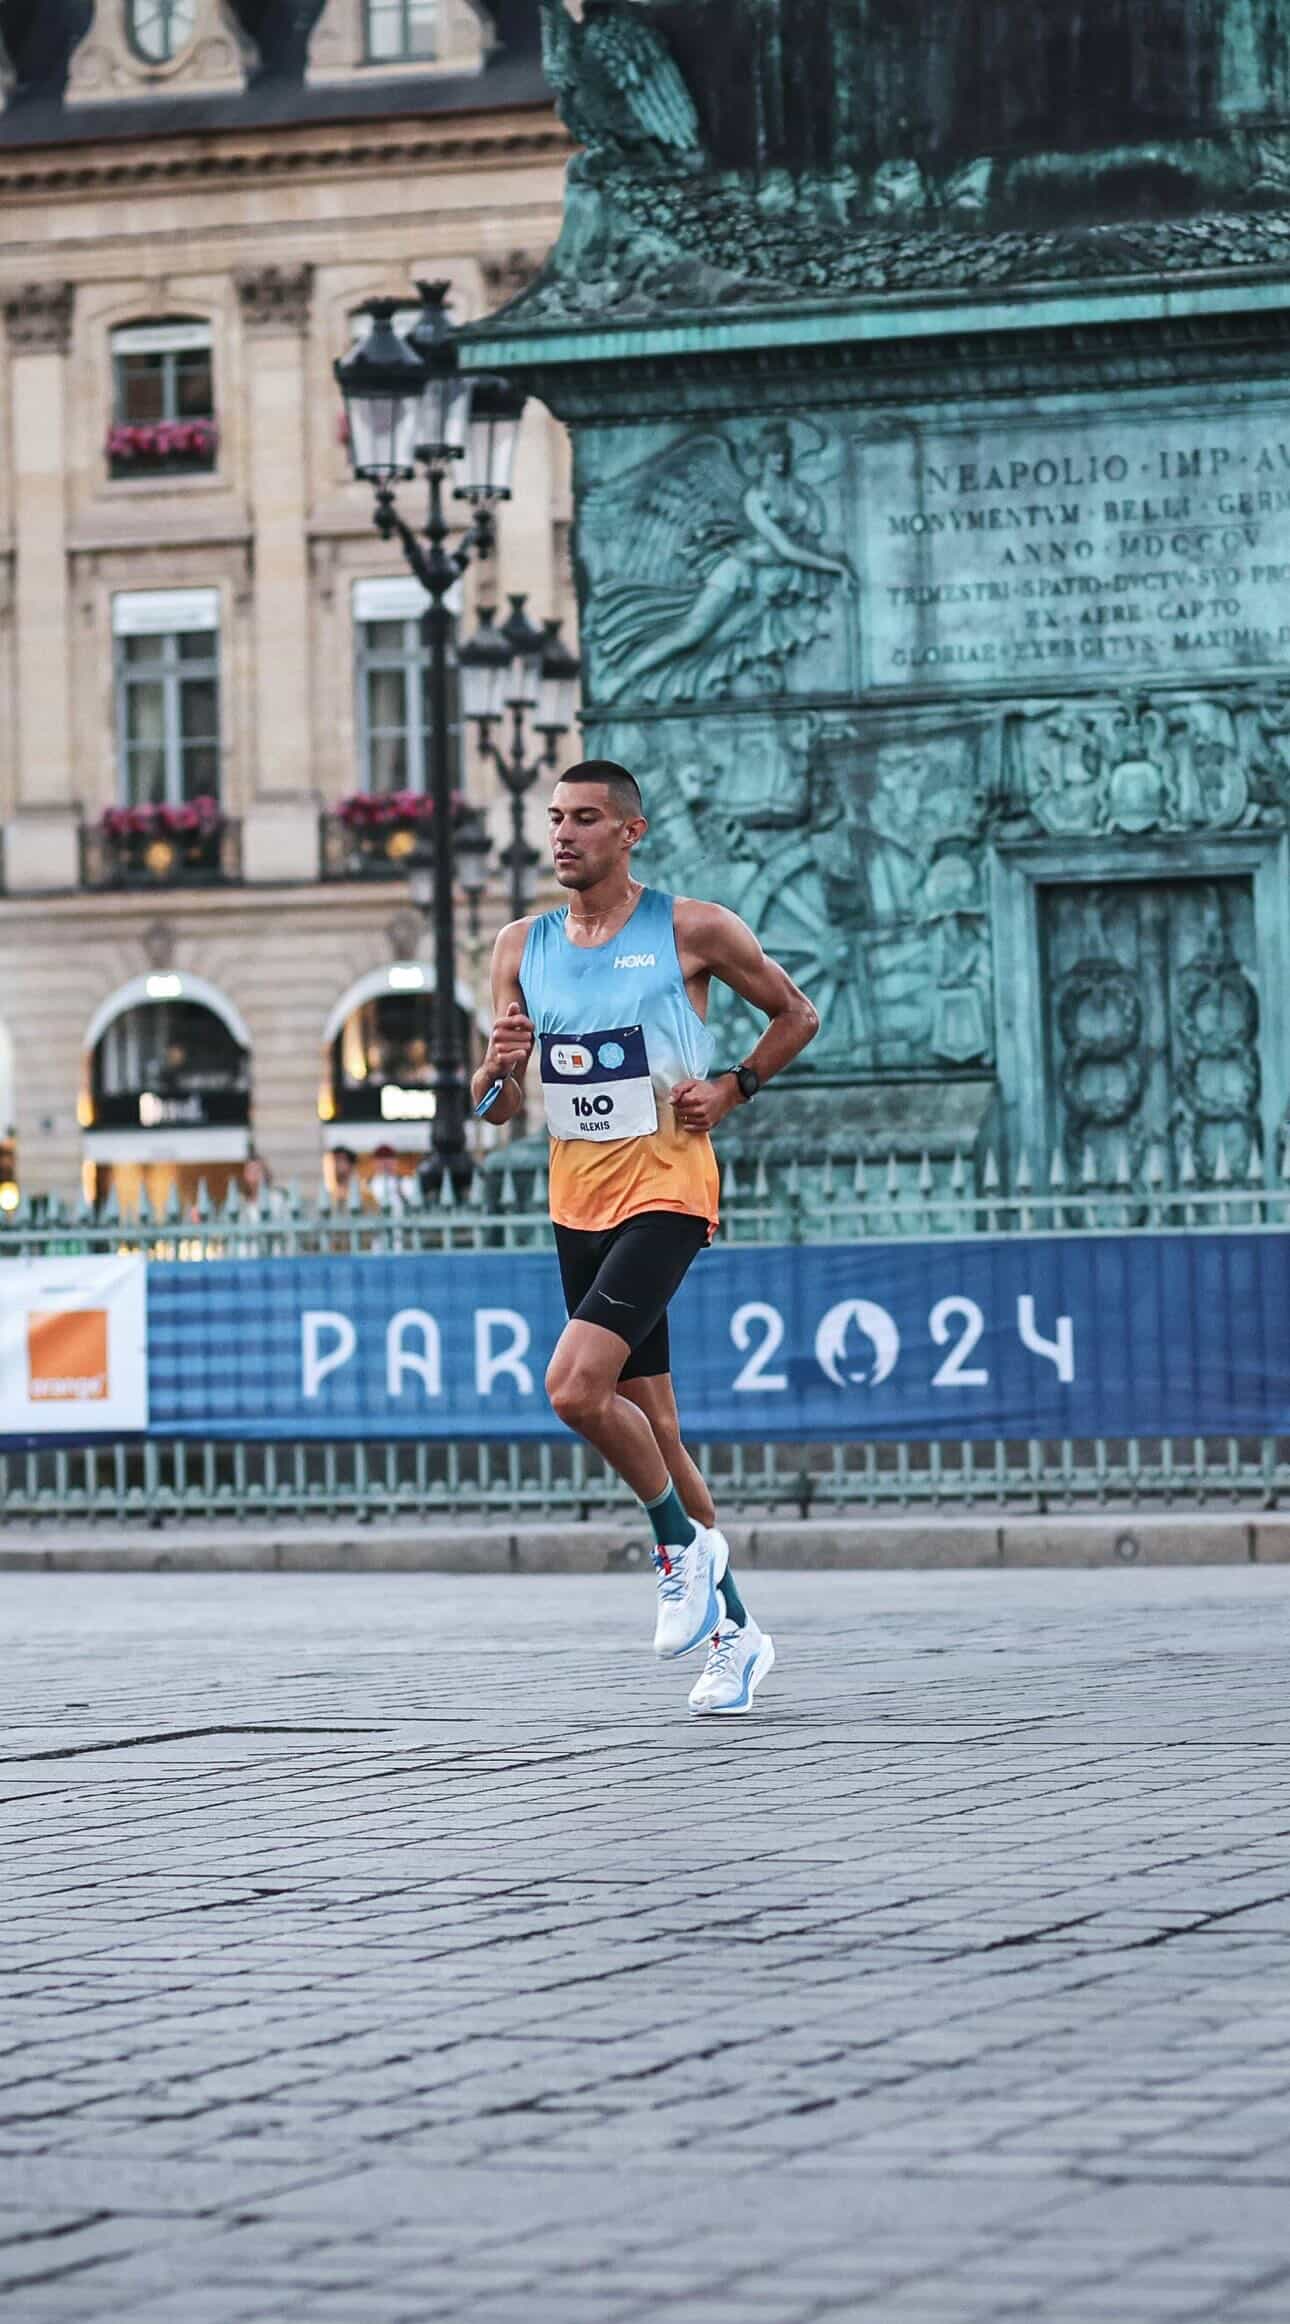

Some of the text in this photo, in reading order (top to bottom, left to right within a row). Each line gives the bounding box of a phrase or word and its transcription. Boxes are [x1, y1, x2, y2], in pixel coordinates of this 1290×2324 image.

[926, 455, 1128, 494] NEAPOLIO
[1160, 448, 1230, 479] IMP
[1001, 540, 1093, 565] ANNO
[1158, 598, 1241, 621] CAPTO
[613, 953, 656, 969] HOKA
[571, 1094, 614, 1117] 160
[580, 1121, 610, 1132] ALEXIS
[301, 1308, 534, 1396] PAR
